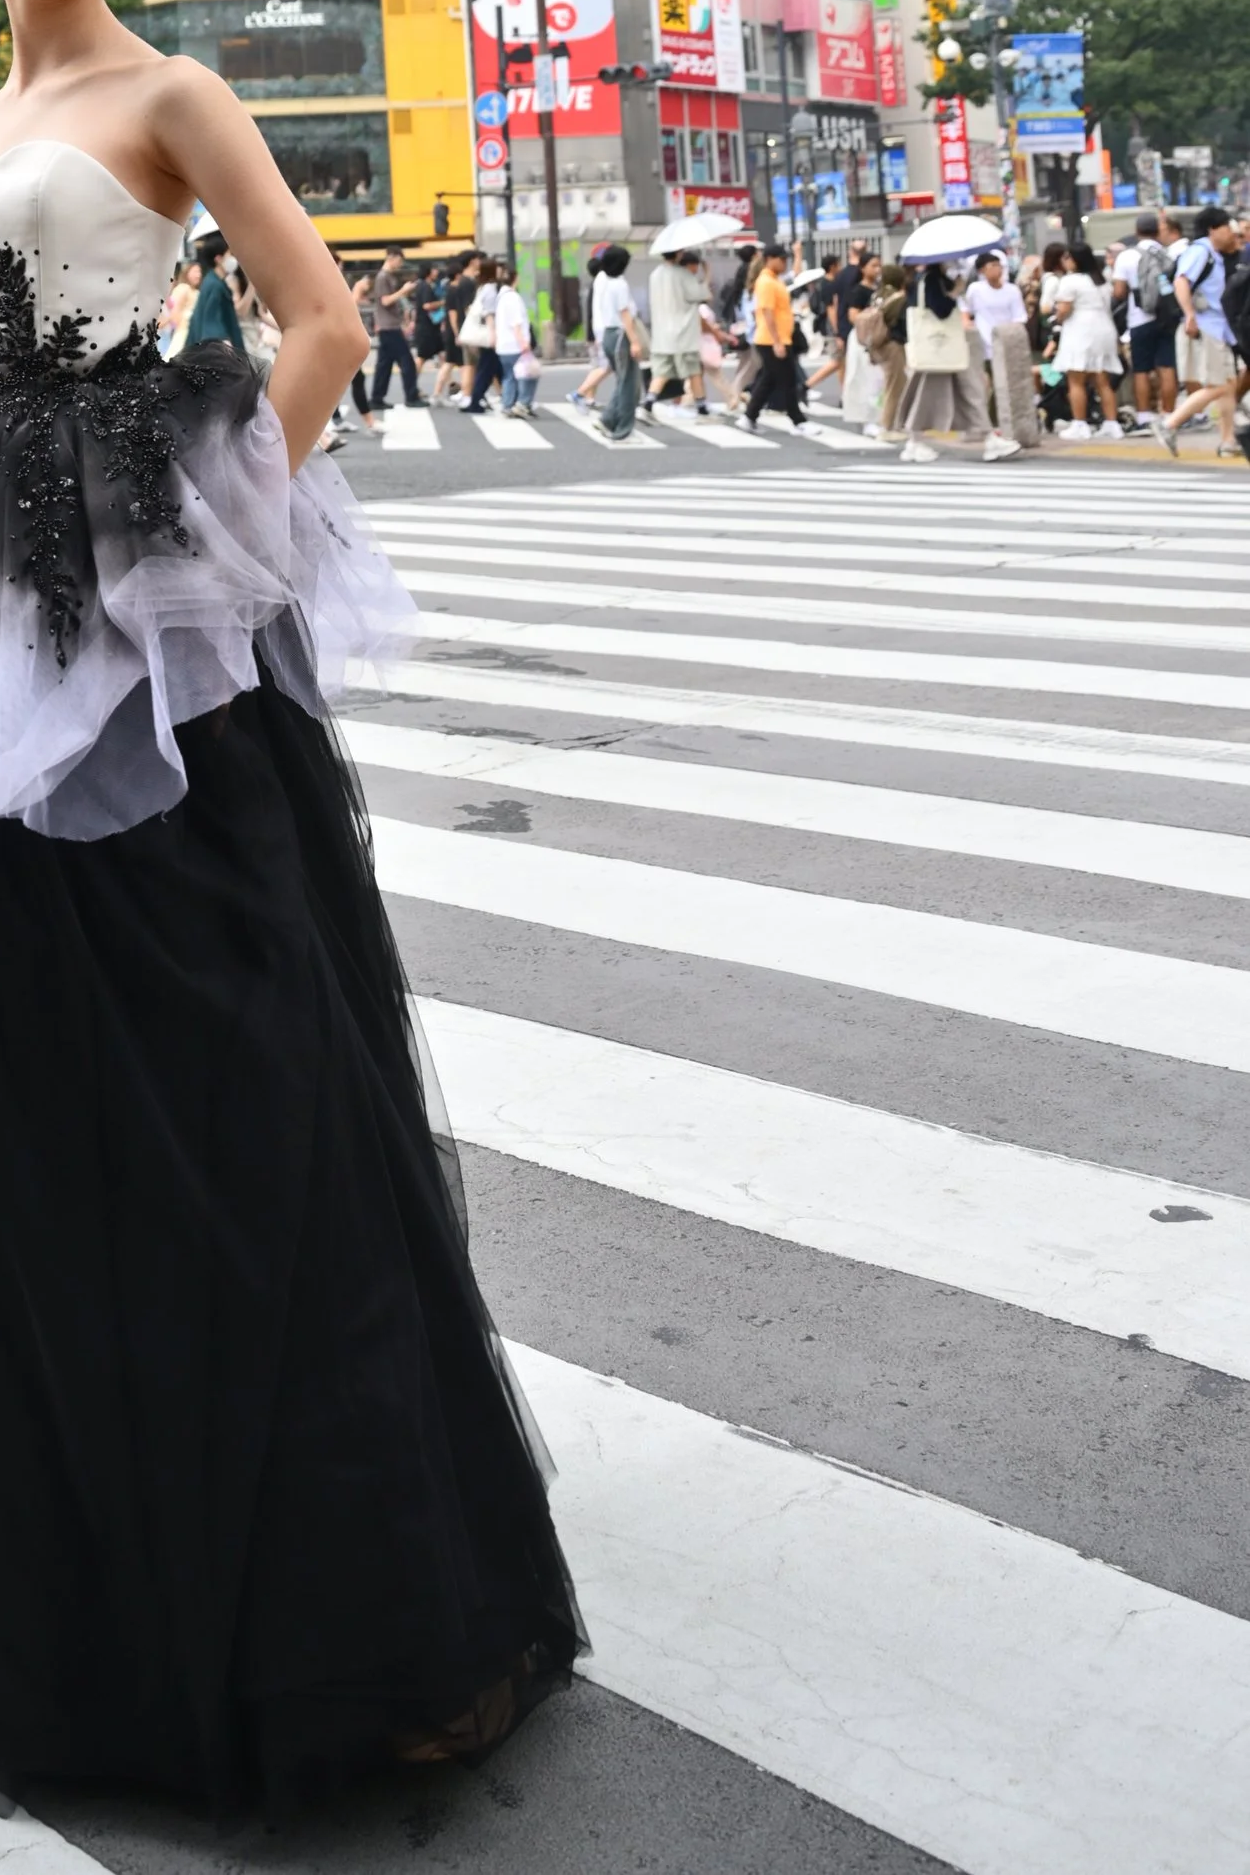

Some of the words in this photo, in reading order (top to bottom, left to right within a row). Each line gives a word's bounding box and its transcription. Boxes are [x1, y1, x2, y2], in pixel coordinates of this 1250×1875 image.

[826, 38, 866, 70] アコム
[812, 114, 867, 151] LUSH
